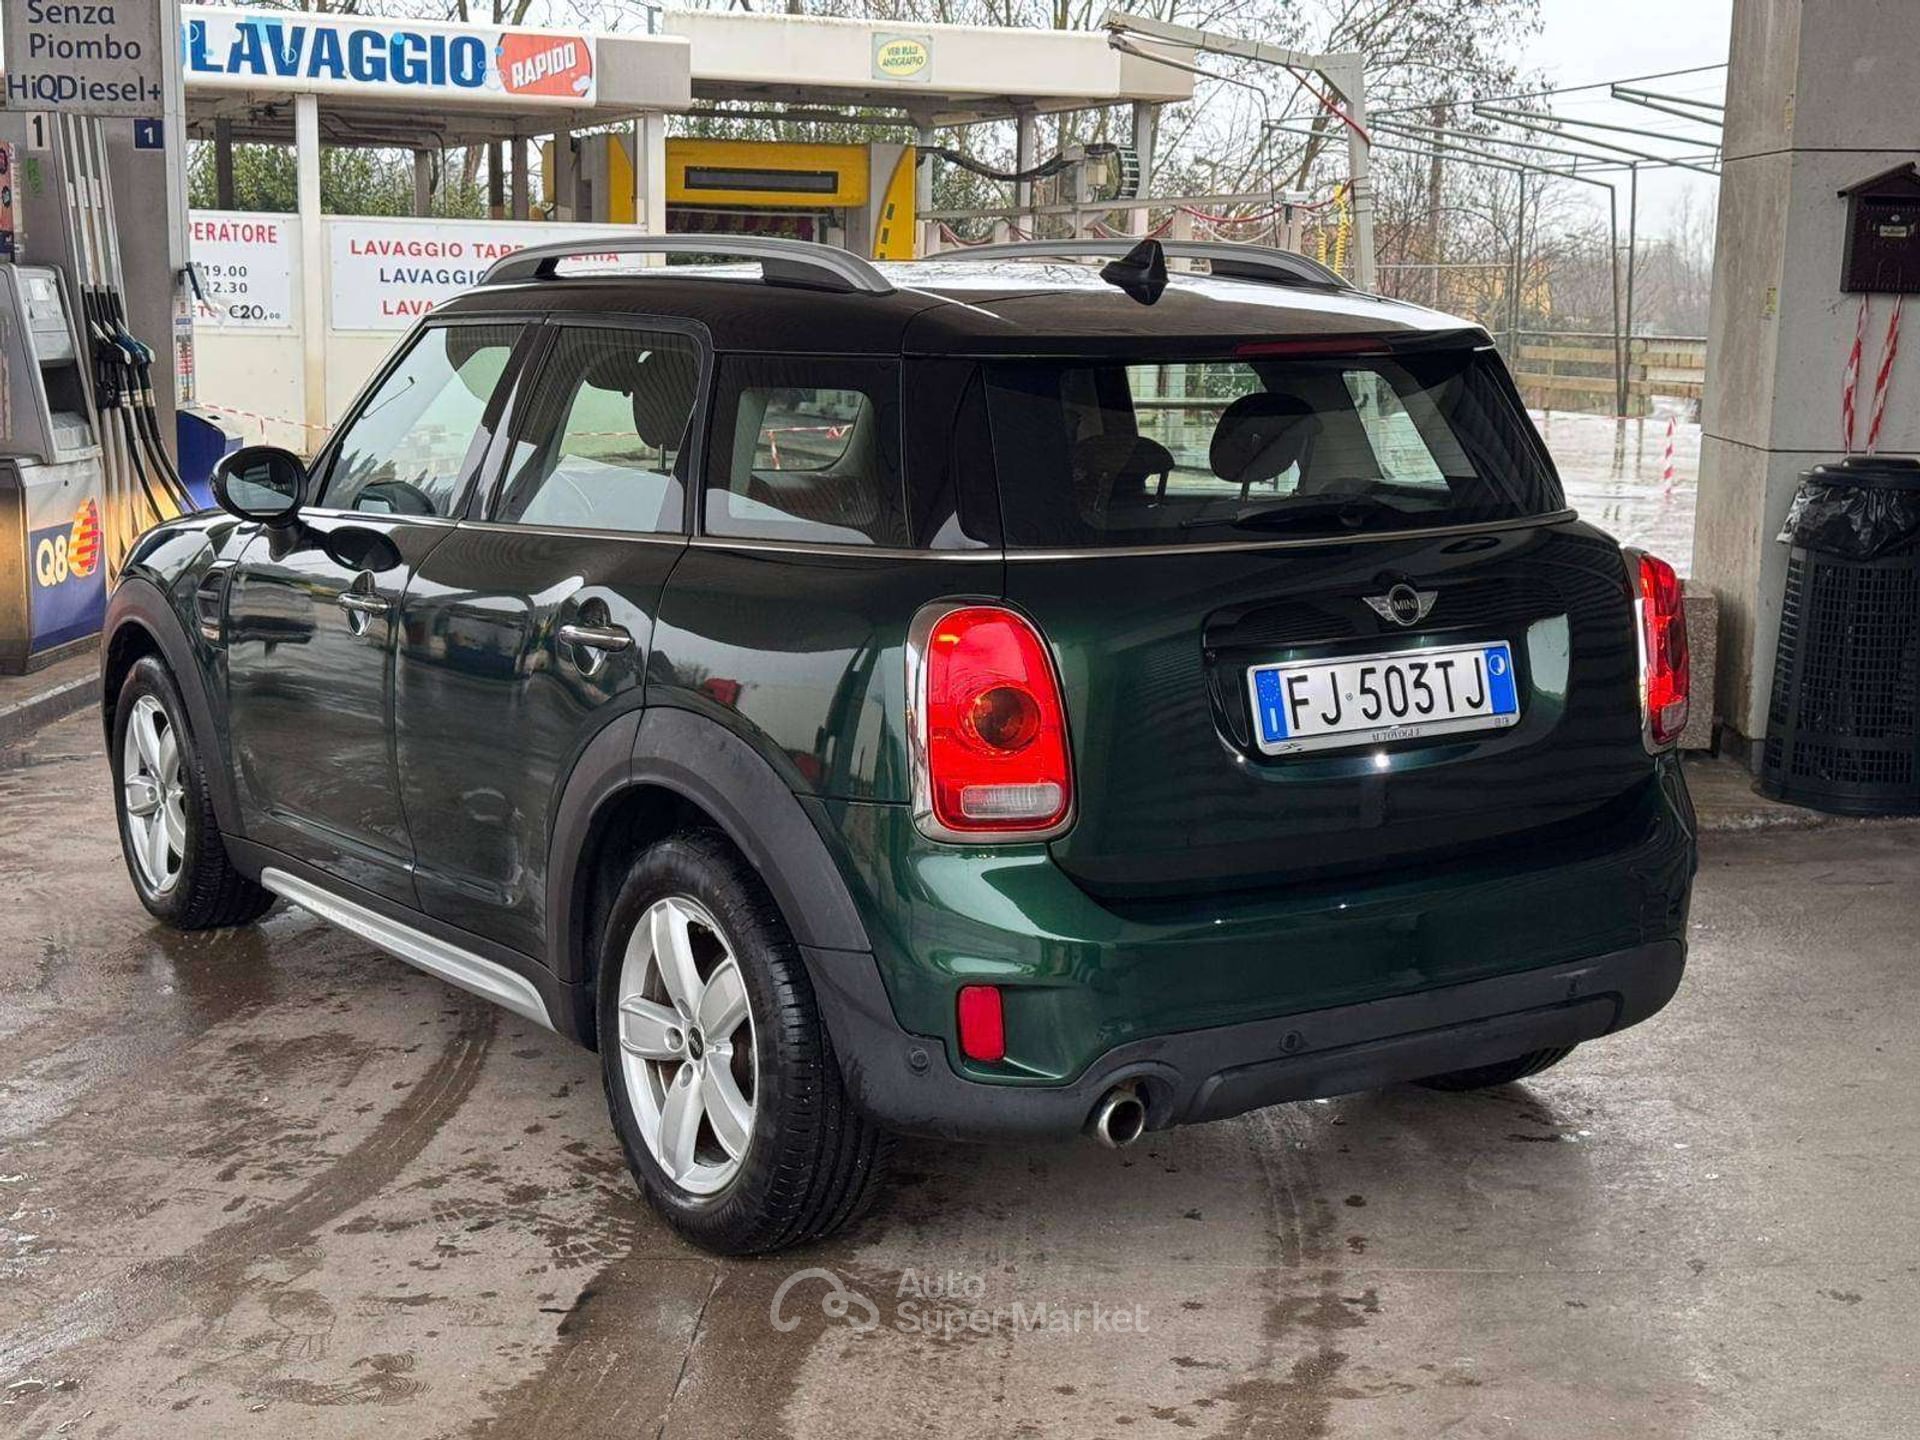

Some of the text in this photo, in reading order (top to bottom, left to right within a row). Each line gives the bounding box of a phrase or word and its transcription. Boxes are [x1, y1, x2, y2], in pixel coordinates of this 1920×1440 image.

[28, 0, 116, 24] Senza
[30, 33, 141, 60] Piombo
[190, 20, 486, 88] LAVAGGIO
[511, 41, 577, 89] RAPIDO
[33, 115, 43, 147] 1
[144, 127, 153, 143] 1
[188, 222, 278, 244] ERATORE
[350, 239, 464, 258] LAVAGGIO
[36, 534, 69, 588] Q8
